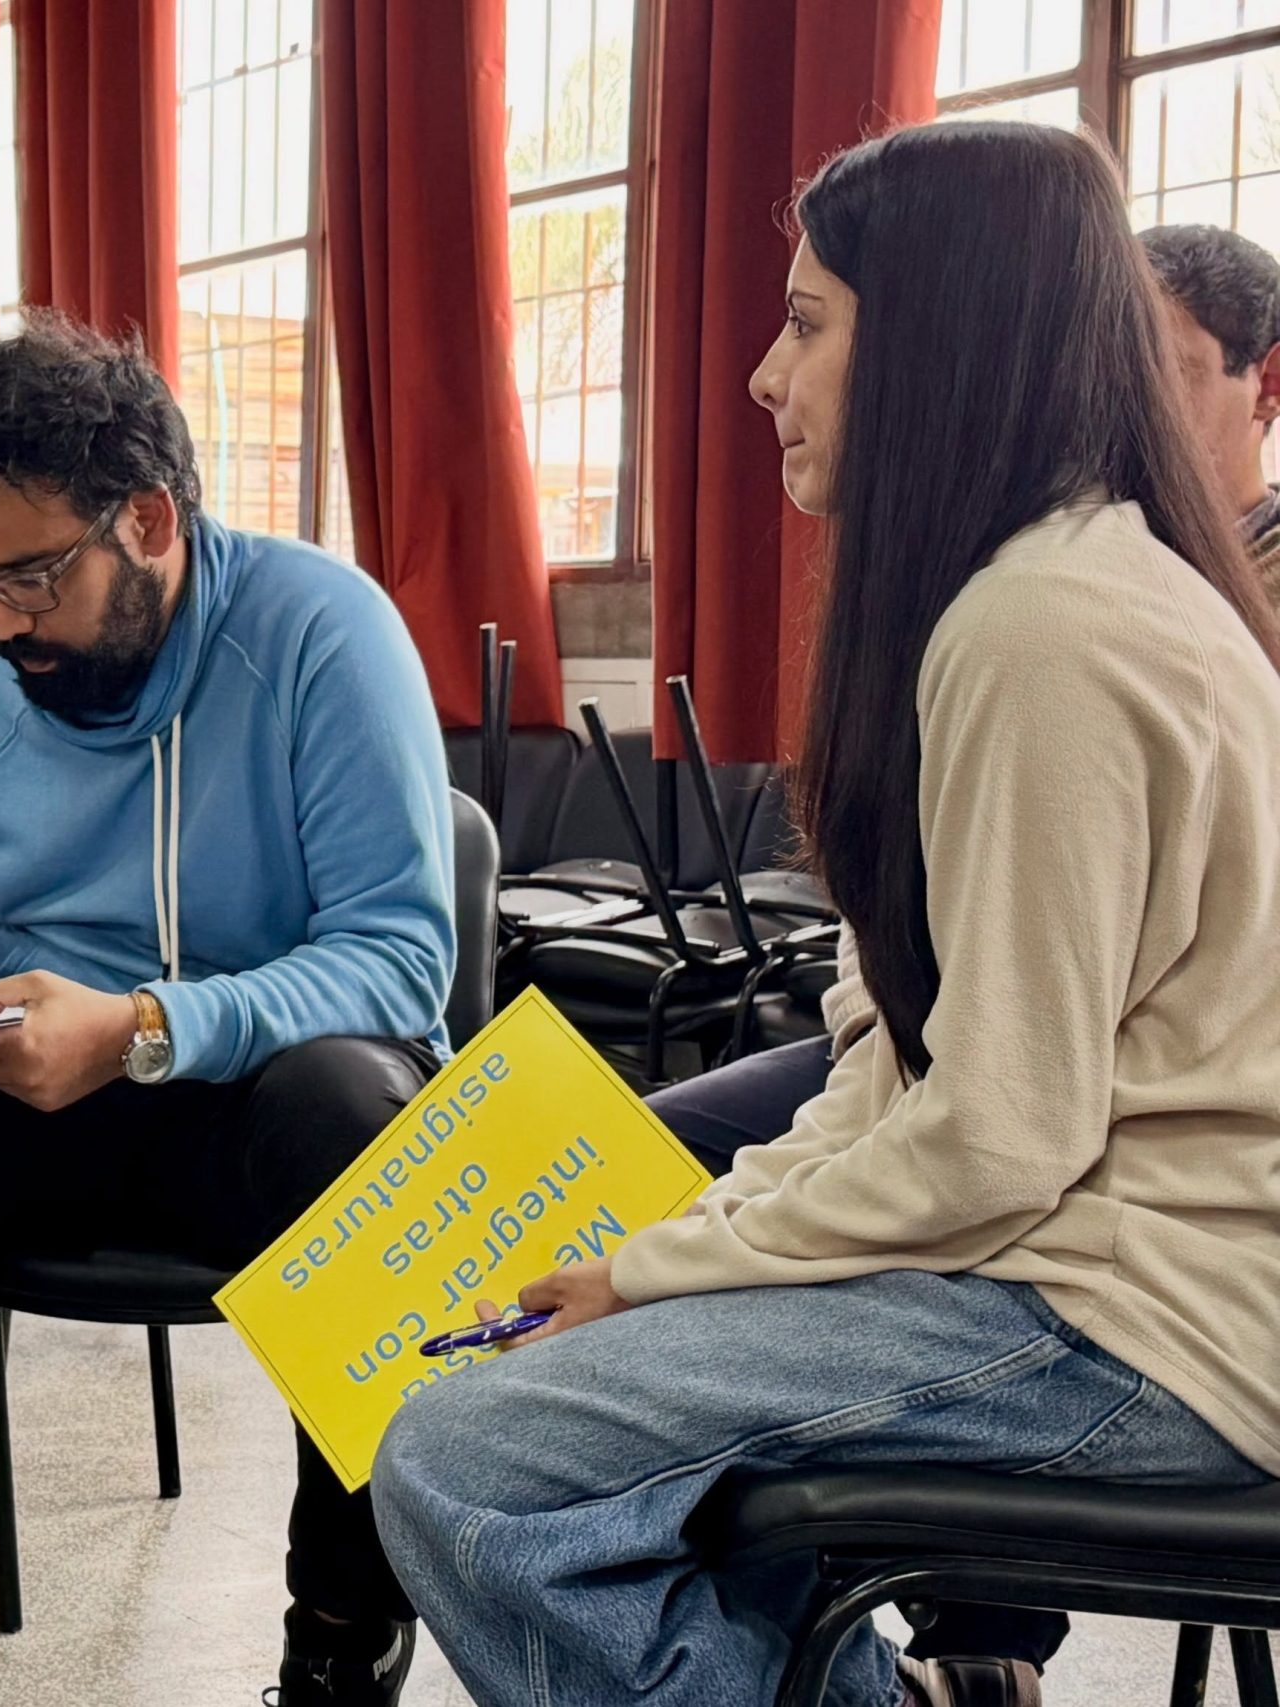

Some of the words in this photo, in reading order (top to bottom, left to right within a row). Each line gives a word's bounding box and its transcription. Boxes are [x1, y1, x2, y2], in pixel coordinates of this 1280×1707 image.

[280, 1051, 511, 1291] asignaturas
[380, 1162, 488, 1276] otras
[440, 1134, 606, 1313] integrar
[344, 1310, 428, 1385] con
